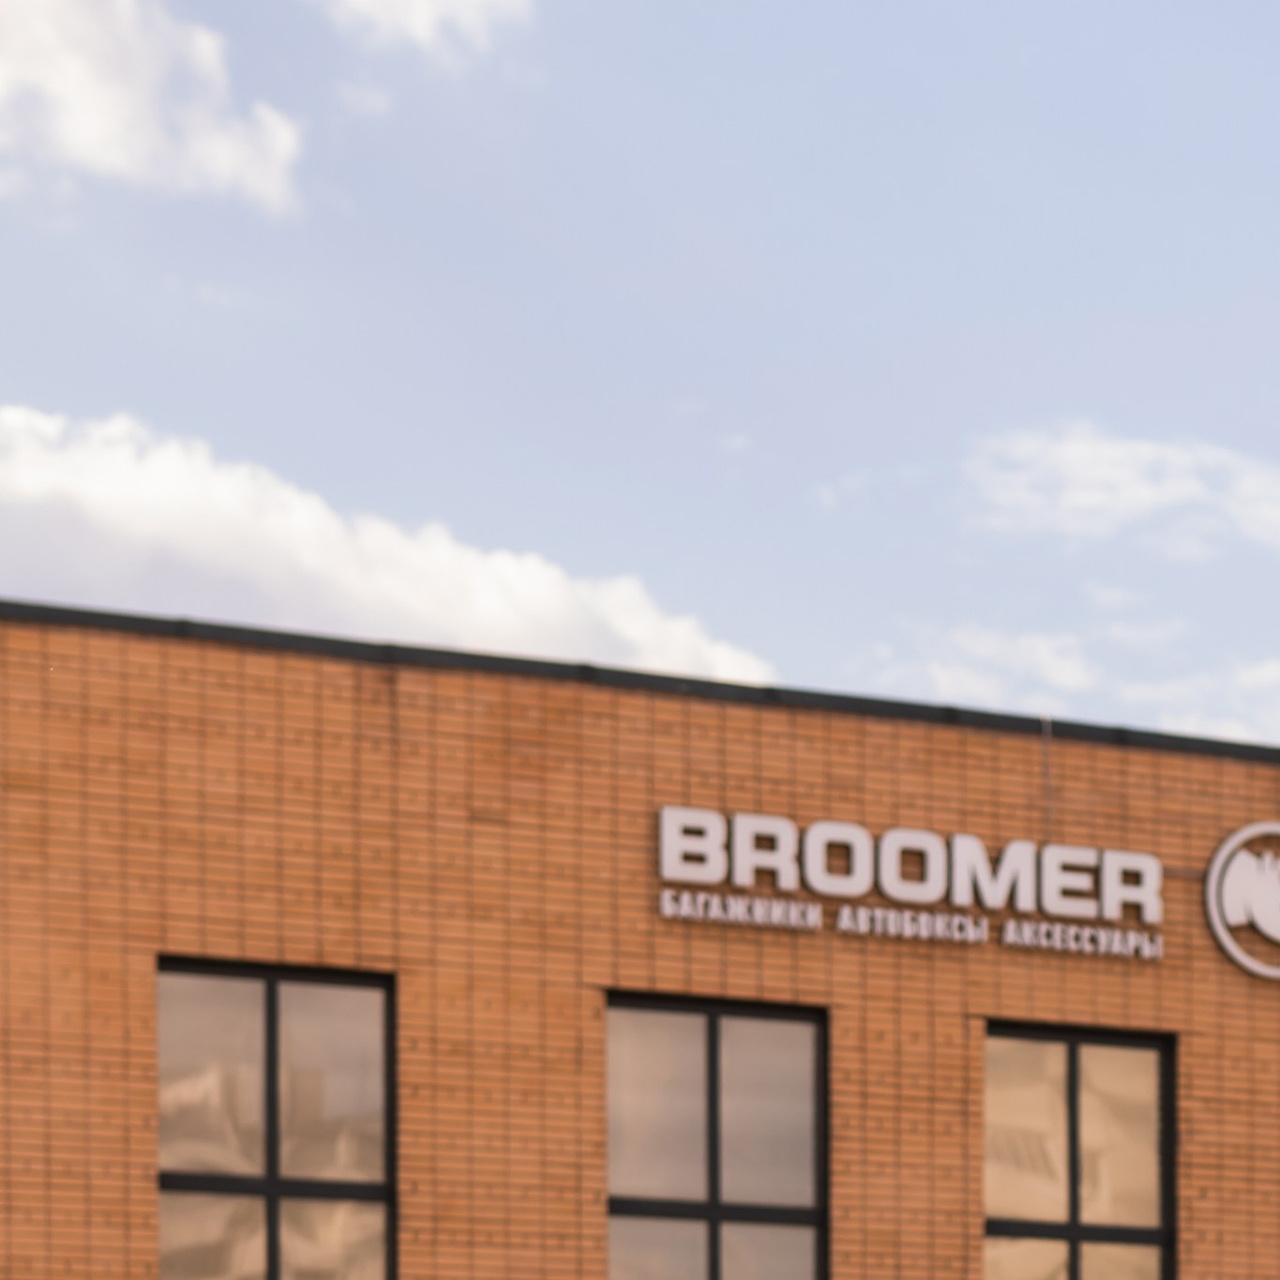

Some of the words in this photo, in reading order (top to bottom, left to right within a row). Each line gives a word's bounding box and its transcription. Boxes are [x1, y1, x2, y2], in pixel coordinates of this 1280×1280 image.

[659, 805, 1163, 924] BROOMER
[660, 888, 823, 930] БАГАЖНИКИ
[837, 904, 989, 944] АВТОБОКСЫ
[1003, 917, 1163, 960] АКСЕССУАРЫ
